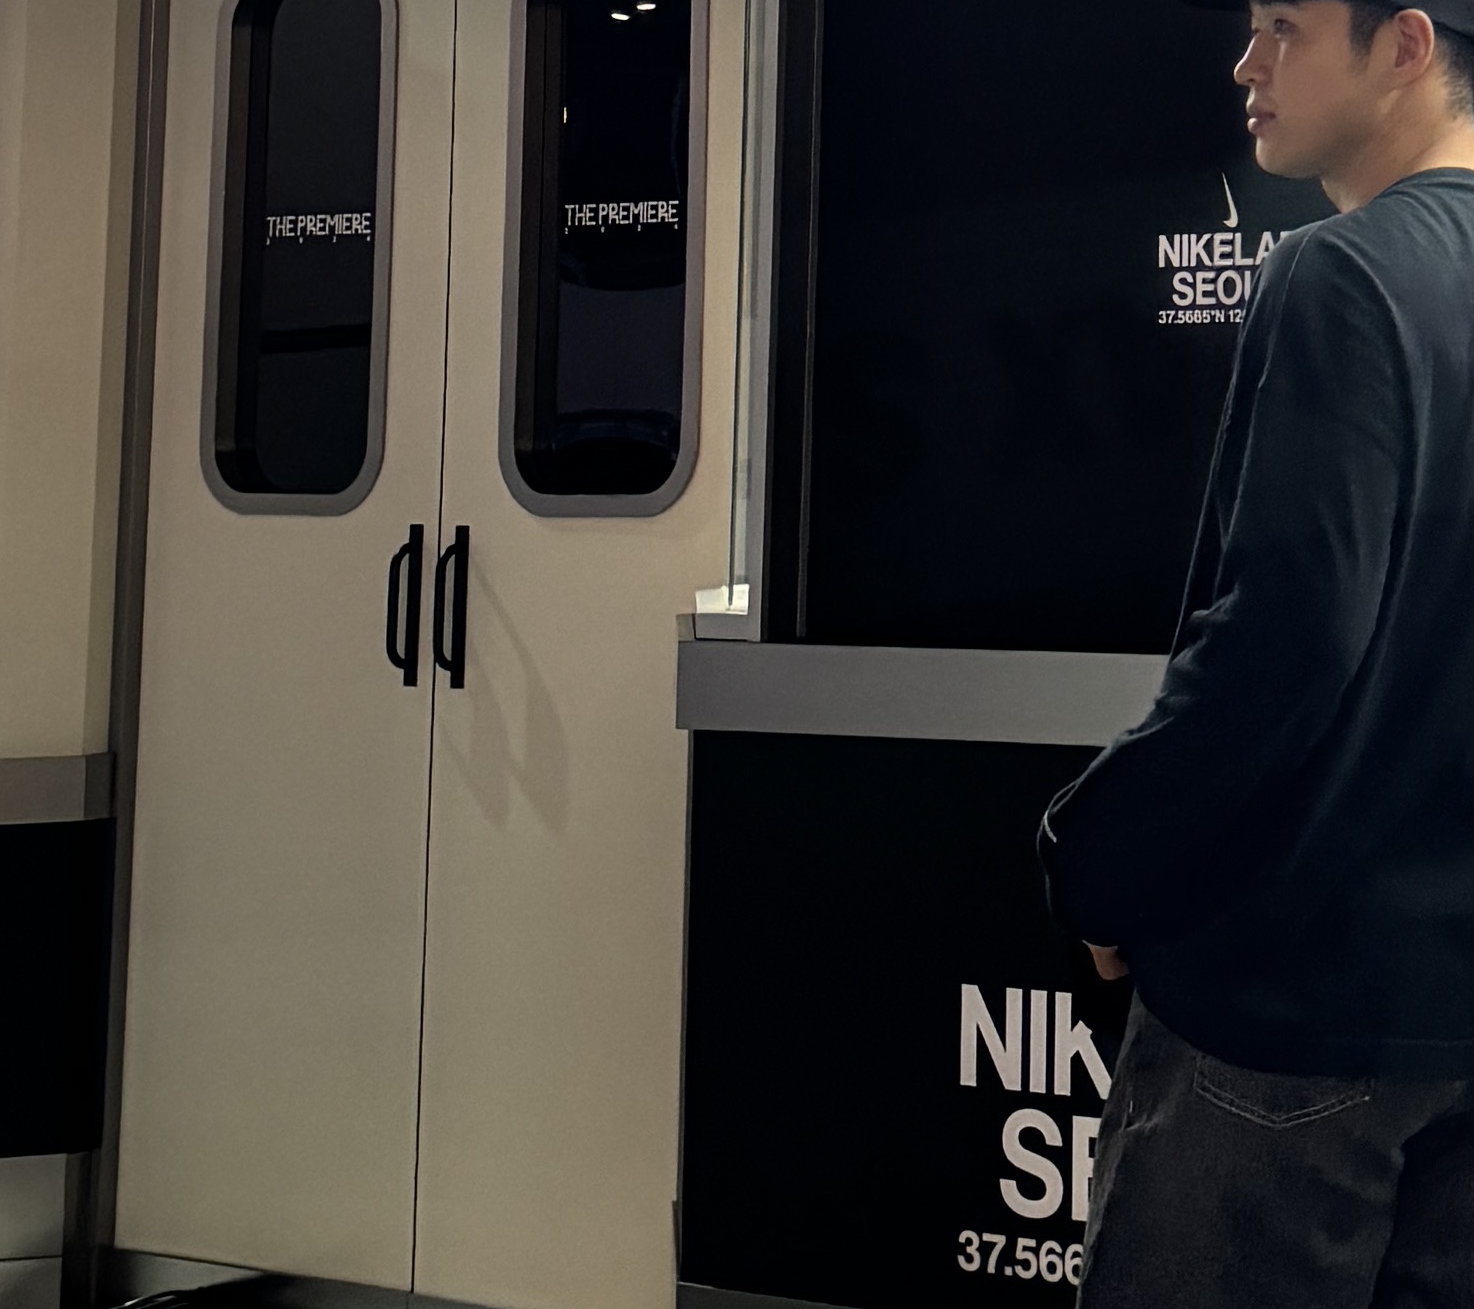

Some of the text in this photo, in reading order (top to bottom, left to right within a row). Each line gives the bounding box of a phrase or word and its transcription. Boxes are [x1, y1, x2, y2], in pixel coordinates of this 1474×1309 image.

[266, 212, 372, 237] THE PREMIERE
[565, 200, 680, 226] THE PREMIERE
[1158, 230, 1291, 268] NIKELA
